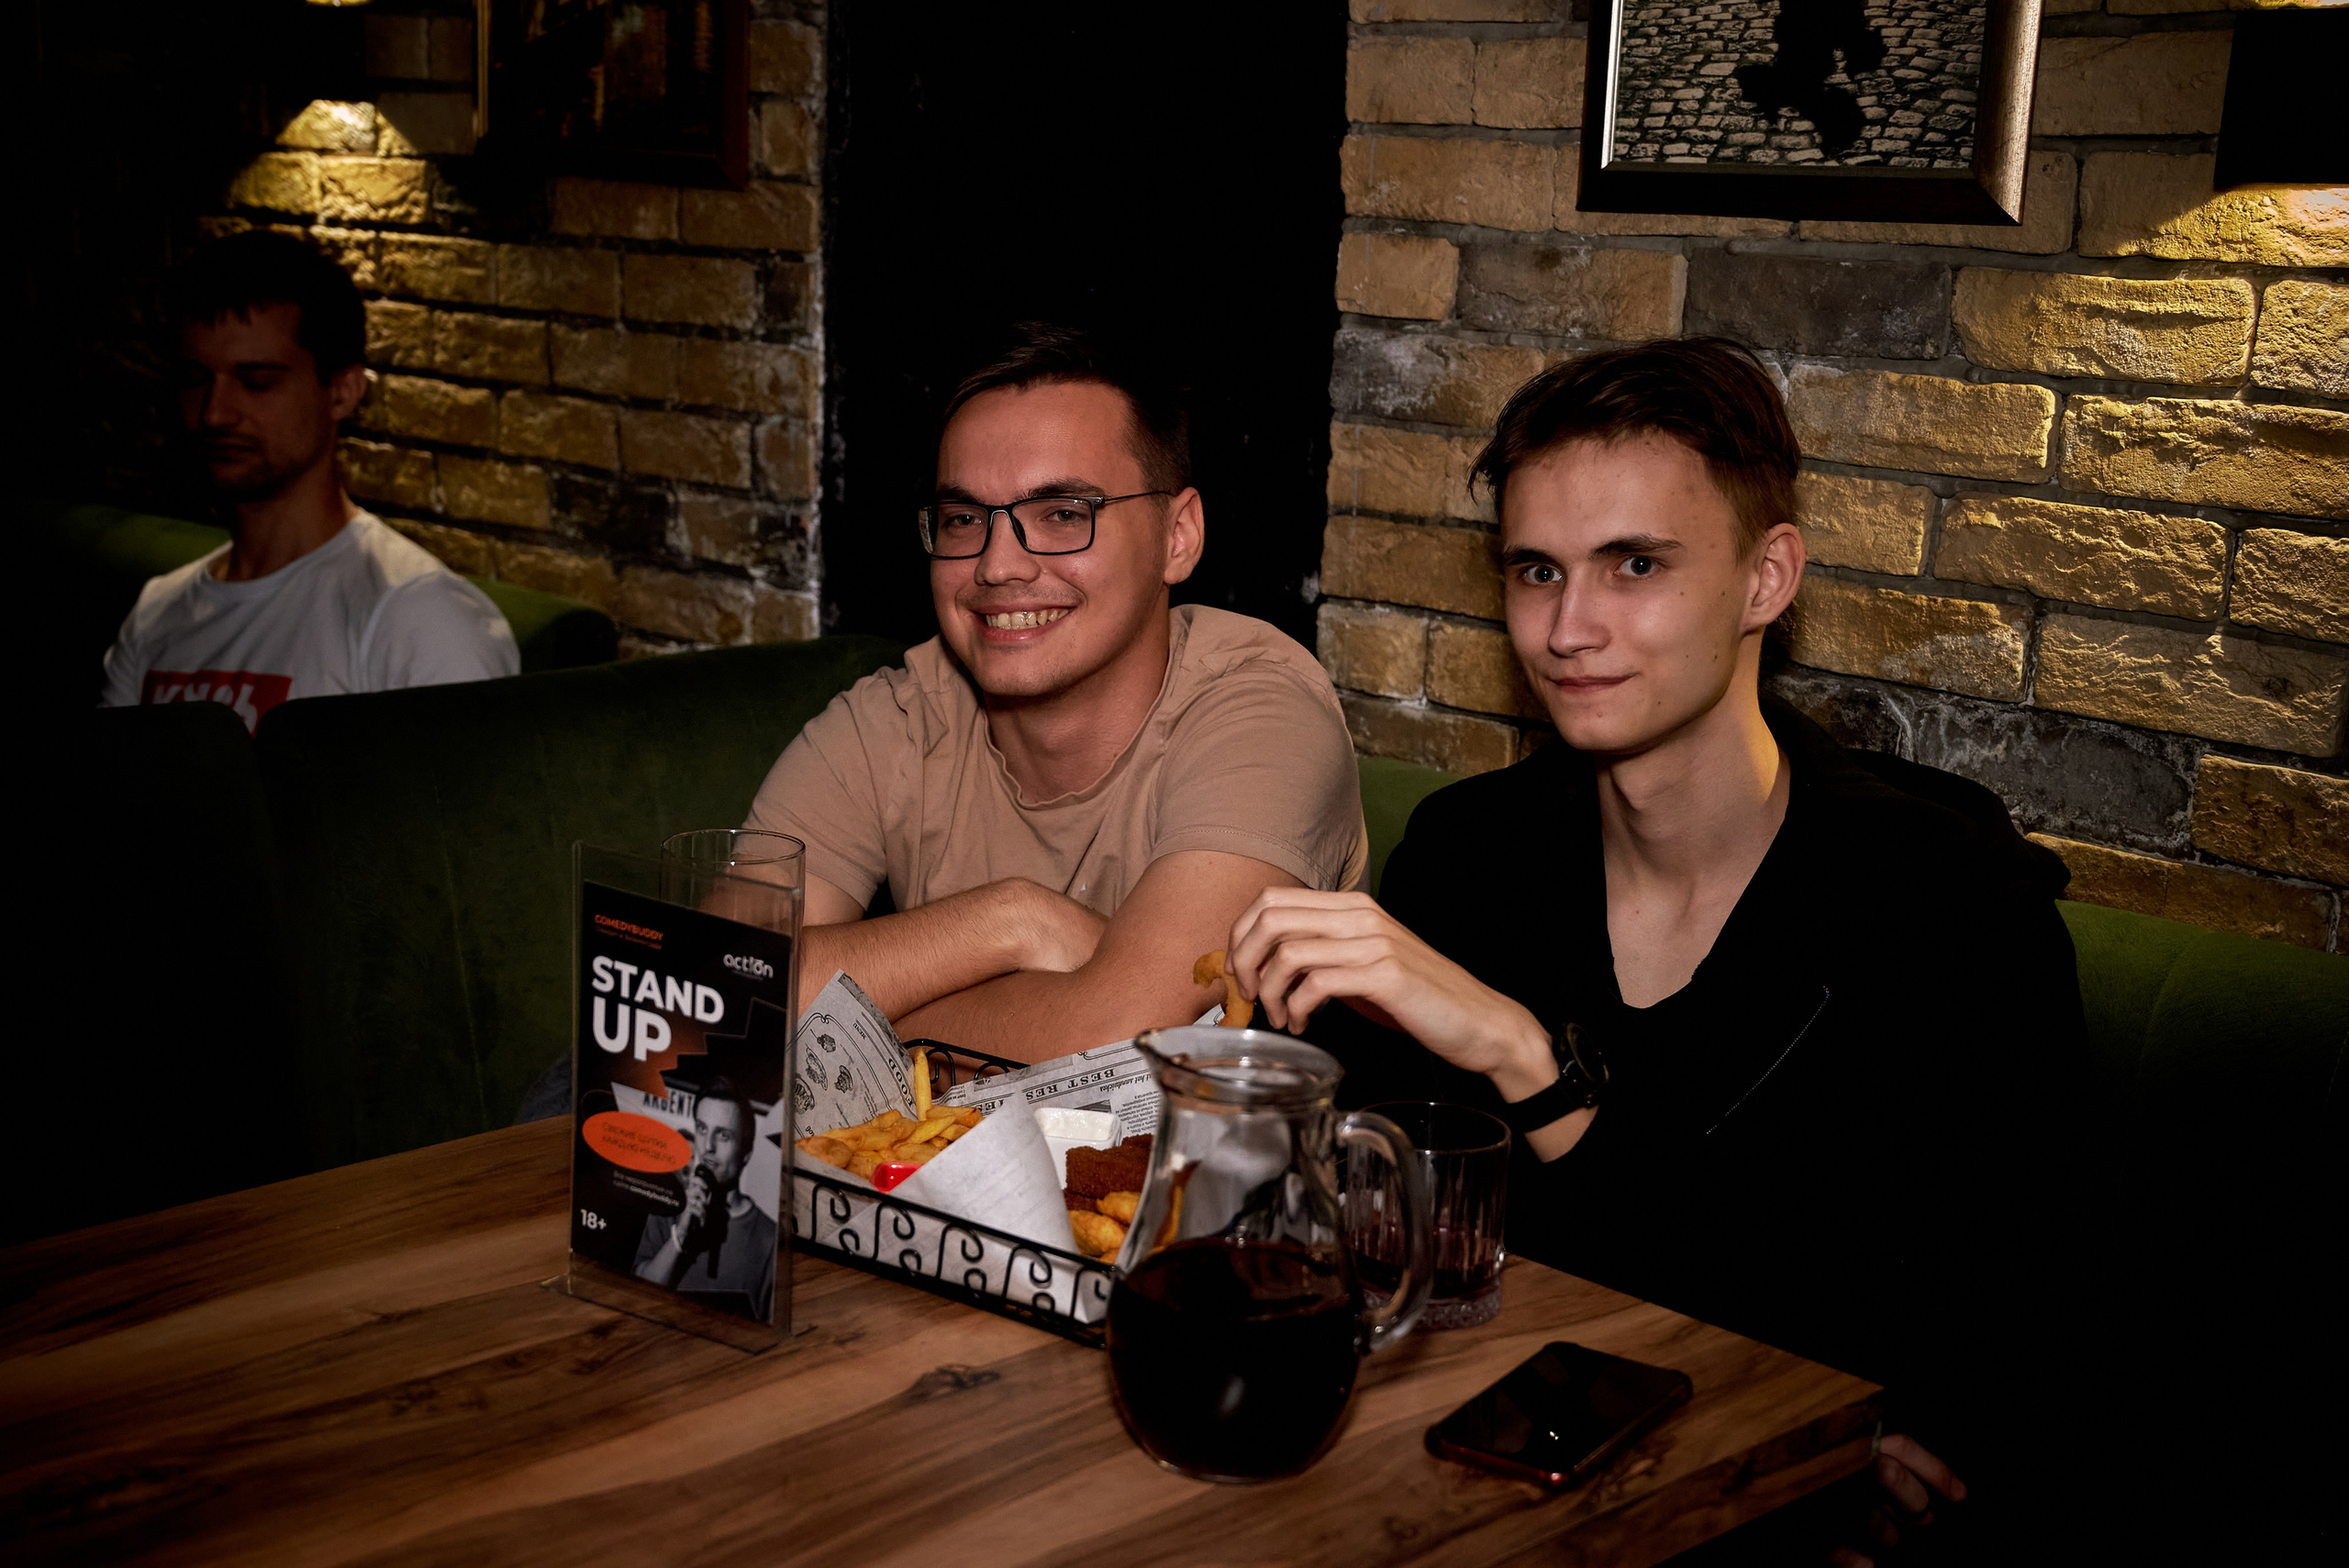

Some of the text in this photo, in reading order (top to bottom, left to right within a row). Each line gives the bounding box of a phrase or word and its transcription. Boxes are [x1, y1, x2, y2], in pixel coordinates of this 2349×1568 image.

[595, 915, 663, 940] COMEDYBUDDY
[592, 955, 725, 1025] STAND
[593, 995, 673, 1062] UP
[852, 1022, 867, 1040] MENU
[888, 1058, 914, 1107] FOOD
[1025, 1069, 1115, 1101] BEST RES
[1099, 1078, 1134, 1092] sandwiches
[580, 1208, 607, 1230] 18+
